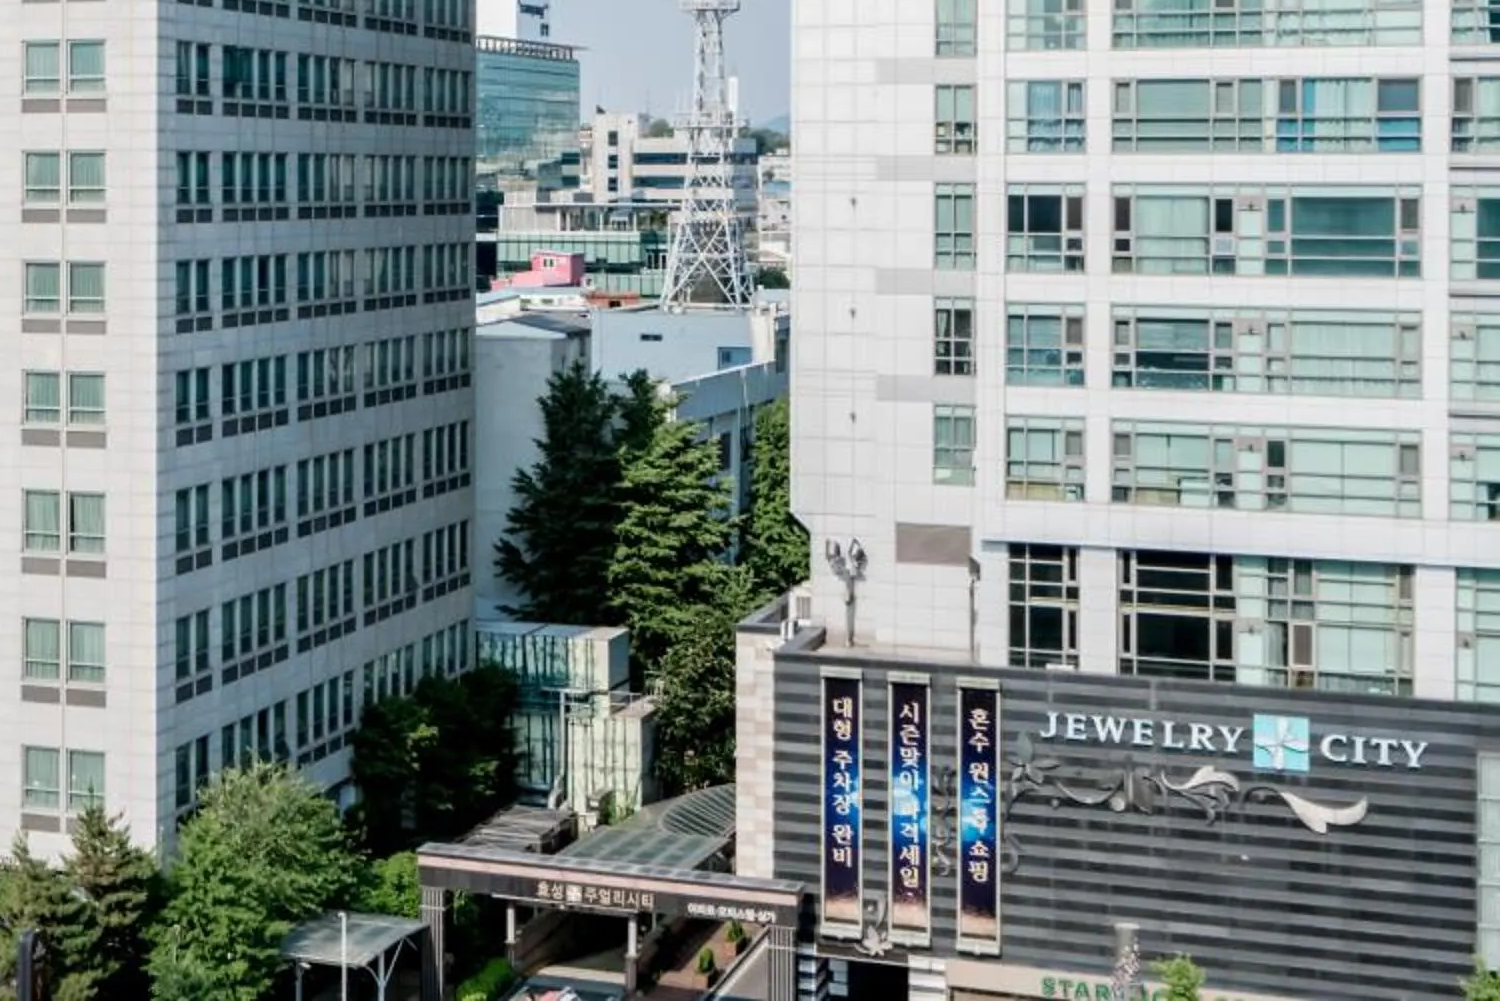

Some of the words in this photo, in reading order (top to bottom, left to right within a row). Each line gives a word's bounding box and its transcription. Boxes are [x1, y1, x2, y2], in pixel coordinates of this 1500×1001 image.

[833, 696, 853, 740] 대형
[968, 707, 991, 753] 혼수
[1040, 711, 1244, 753] JEWELRY
[1320, 734, 1429, 768] CITY
[832, 750, 853, 815] 주차장
[832, 824, 853, 868] 완비
[968, 840, 991, 883] 쇼핑
[584, 886, 655, 911] 주얼리시티
